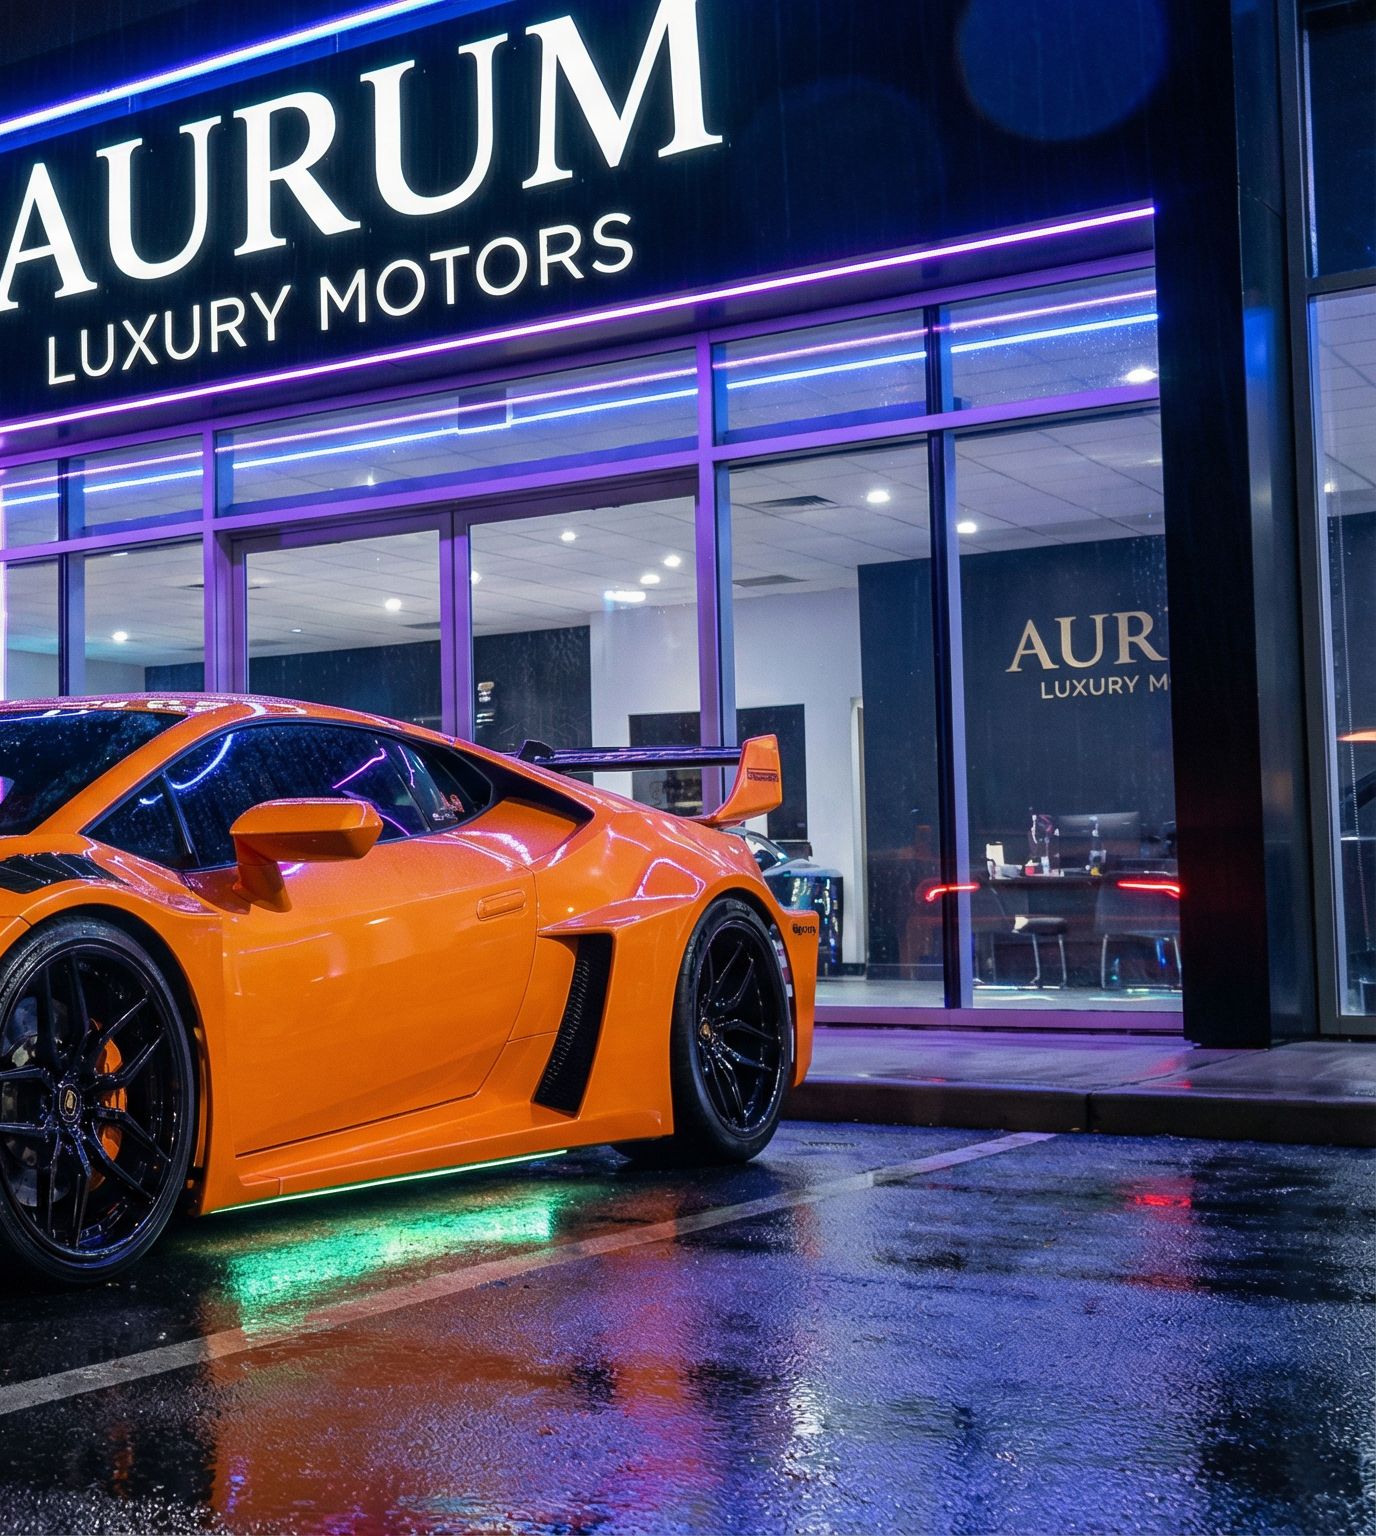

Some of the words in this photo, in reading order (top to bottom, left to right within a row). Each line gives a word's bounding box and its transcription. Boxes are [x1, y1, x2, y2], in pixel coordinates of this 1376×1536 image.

[47, 283, 292, 386] LUXURY
[319, 212, 634, 331] MOTORS
[1005, 611, 1168, 672] AUR
[1040, 675, 1140, 699] LUXURY
[1149, 673, 1171, 692] M
